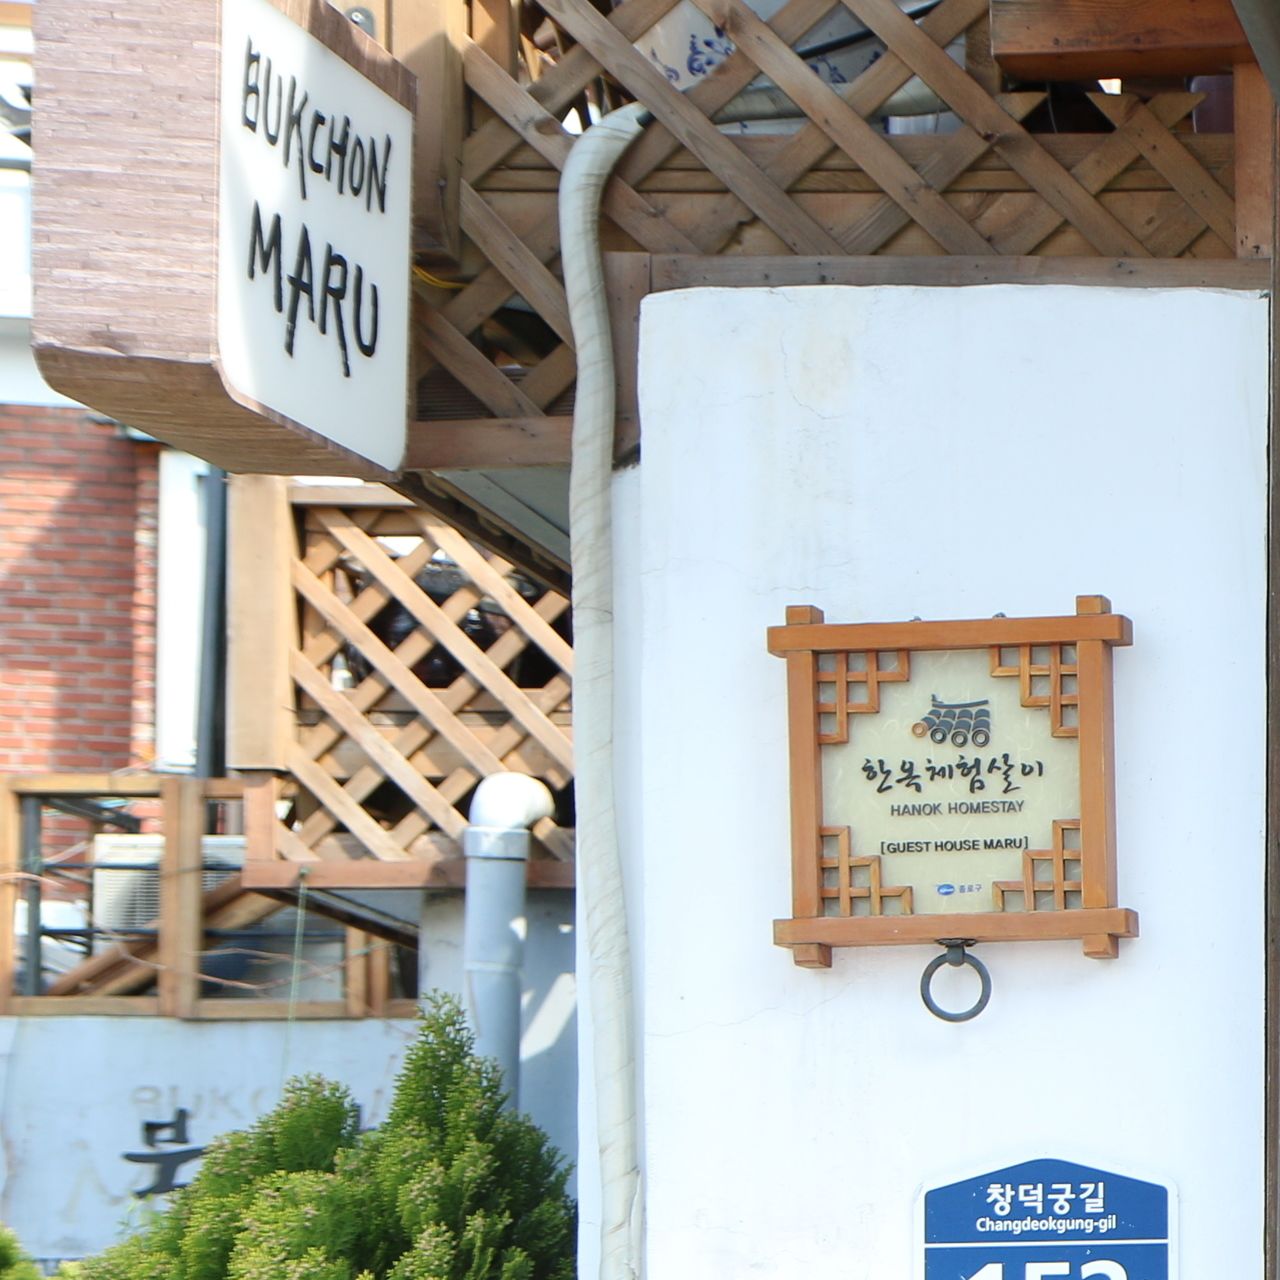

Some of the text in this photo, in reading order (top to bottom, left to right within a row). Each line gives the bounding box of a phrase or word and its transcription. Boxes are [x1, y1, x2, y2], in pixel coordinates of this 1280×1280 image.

[242, 33, 392, 214] BUKCHON
[246, 199, 379, 378] MARU
[861, 752, 1044, 794] 한옥체험살이
[890, 800, 1025, 816] HANOK HOMESTAY
[934, 839, 981, 852] HOUSE
[986, 1182, 1105, 1216] 창덕궁길
[976, 1215, 1117, 1235] Changdeokgung-gil
